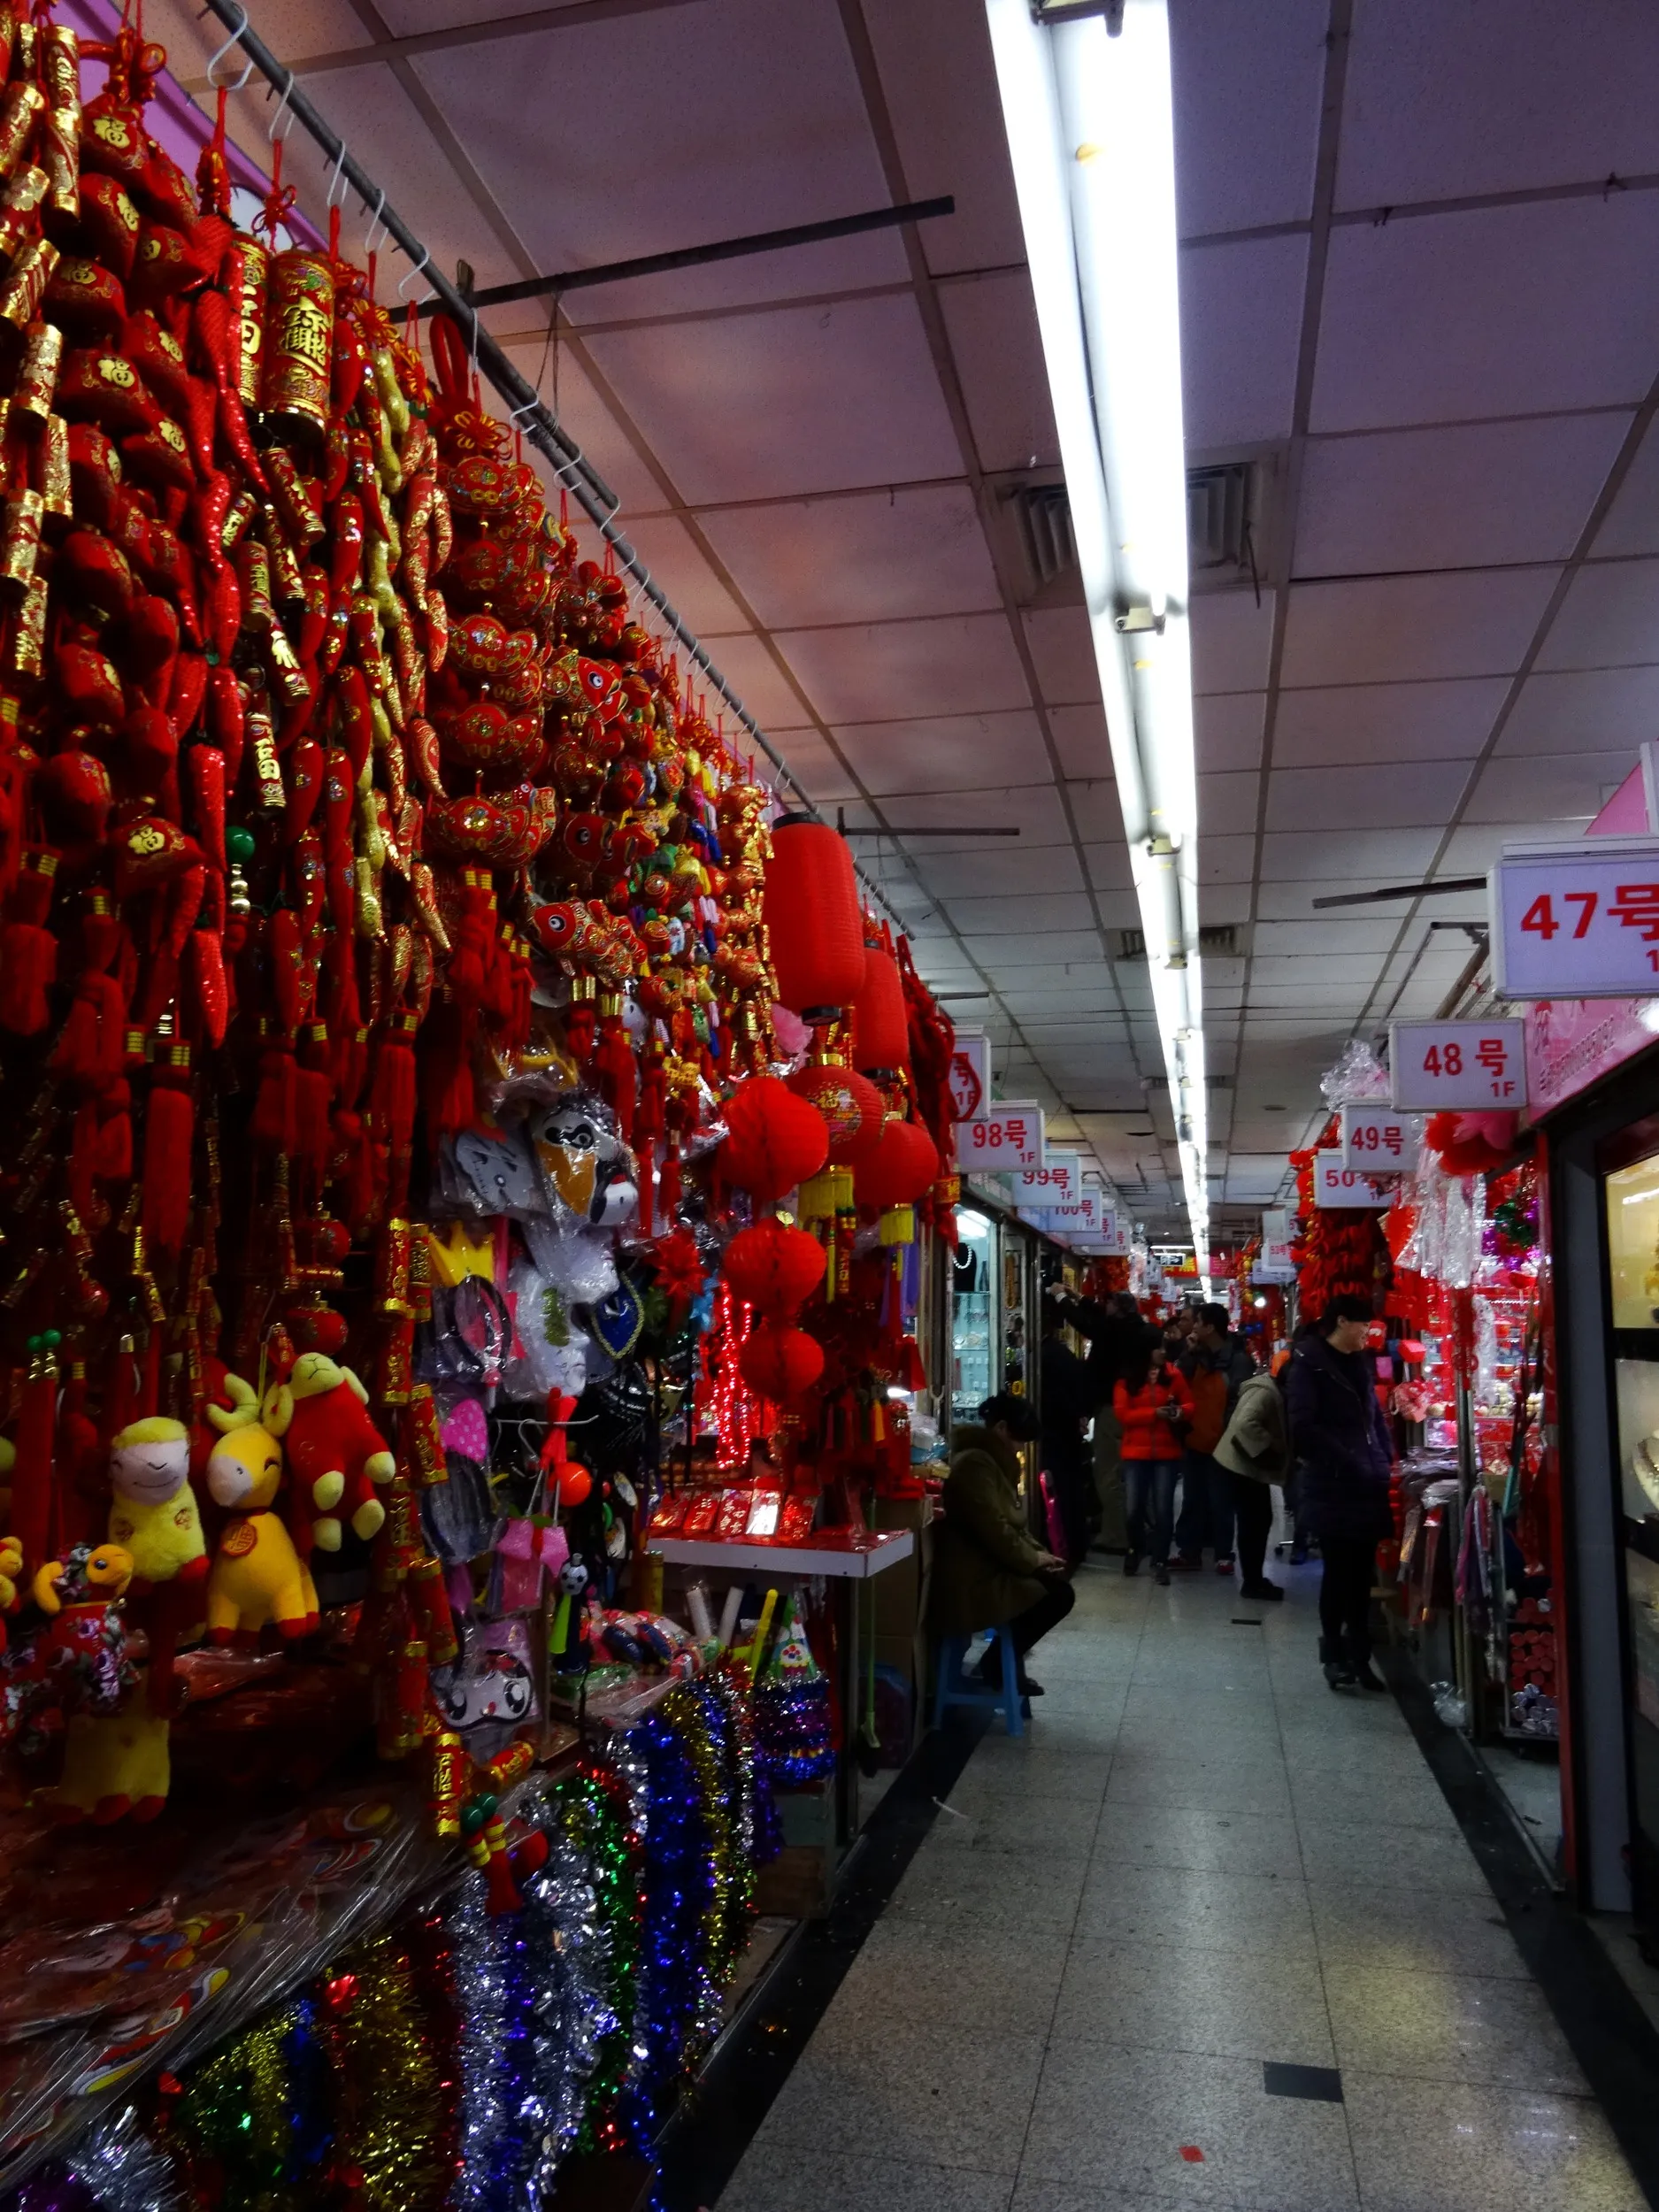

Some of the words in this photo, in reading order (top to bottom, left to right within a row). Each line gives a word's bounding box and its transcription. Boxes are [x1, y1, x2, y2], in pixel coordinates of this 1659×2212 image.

[93, 115, 130, 149] 福
[97, 354, 135, 388] 福
[127, 825, 165, 855] 福
[1521, 884, 1659, 941] 47号
[1490, 1080, 1516, 1097] 1F
[972, 1119, 1027, 1149] 98号
[1350, 1126, 1404, 1156] 49号
[1019, 1151, 1035, 1164] 1F
[1022, 1168, 1071, 1189] 99号
[1060, 1190, 1074, 1200] 1F
